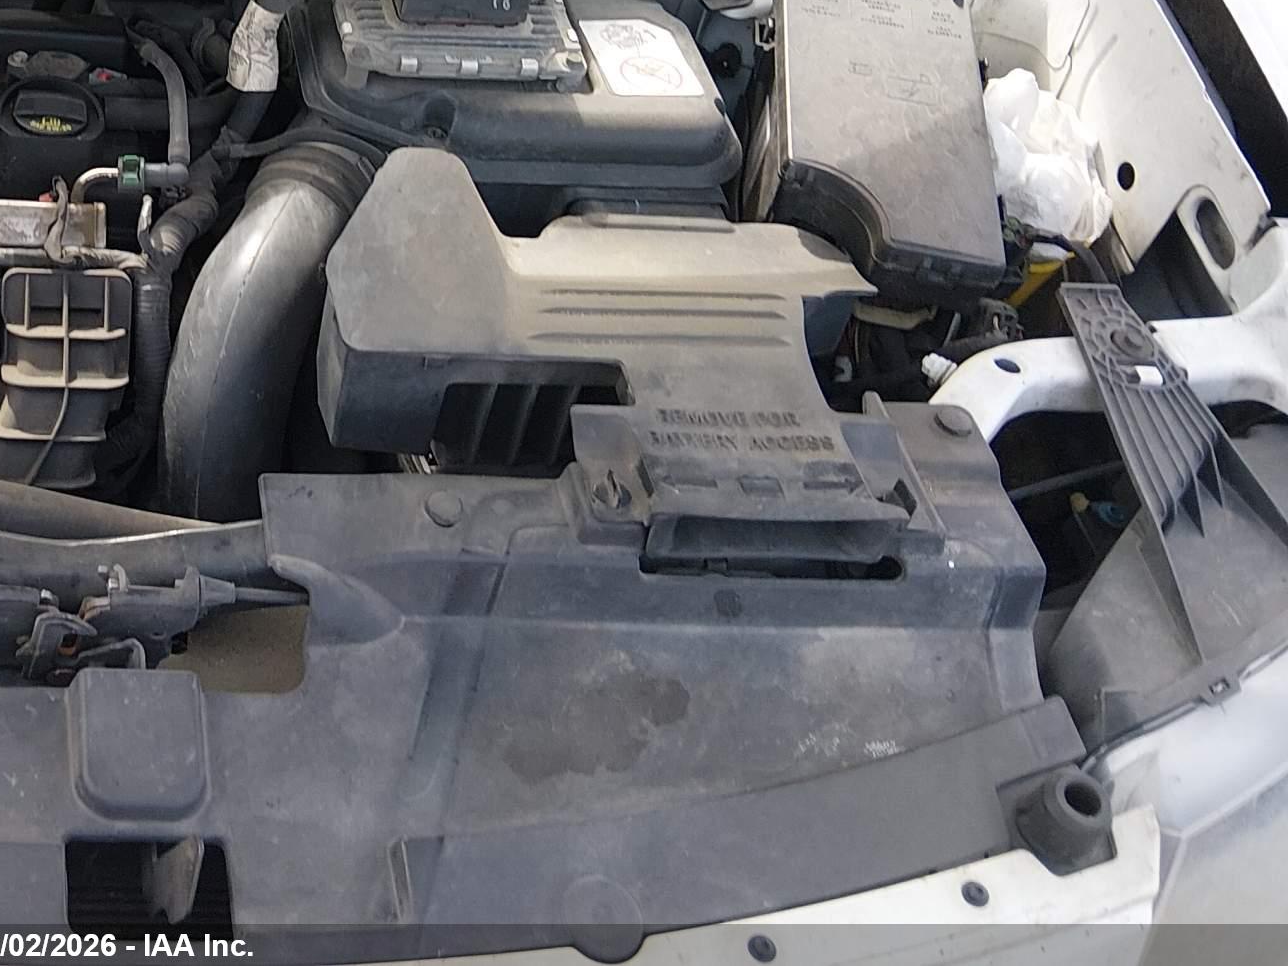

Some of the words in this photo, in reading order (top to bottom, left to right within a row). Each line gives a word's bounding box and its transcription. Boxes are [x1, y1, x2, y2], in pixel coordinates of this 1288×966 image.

[658, 408, 749, 427] REMOVE
[754, 410, 801, 428] FOR
[749, 435, 834, 451] ACCESS
